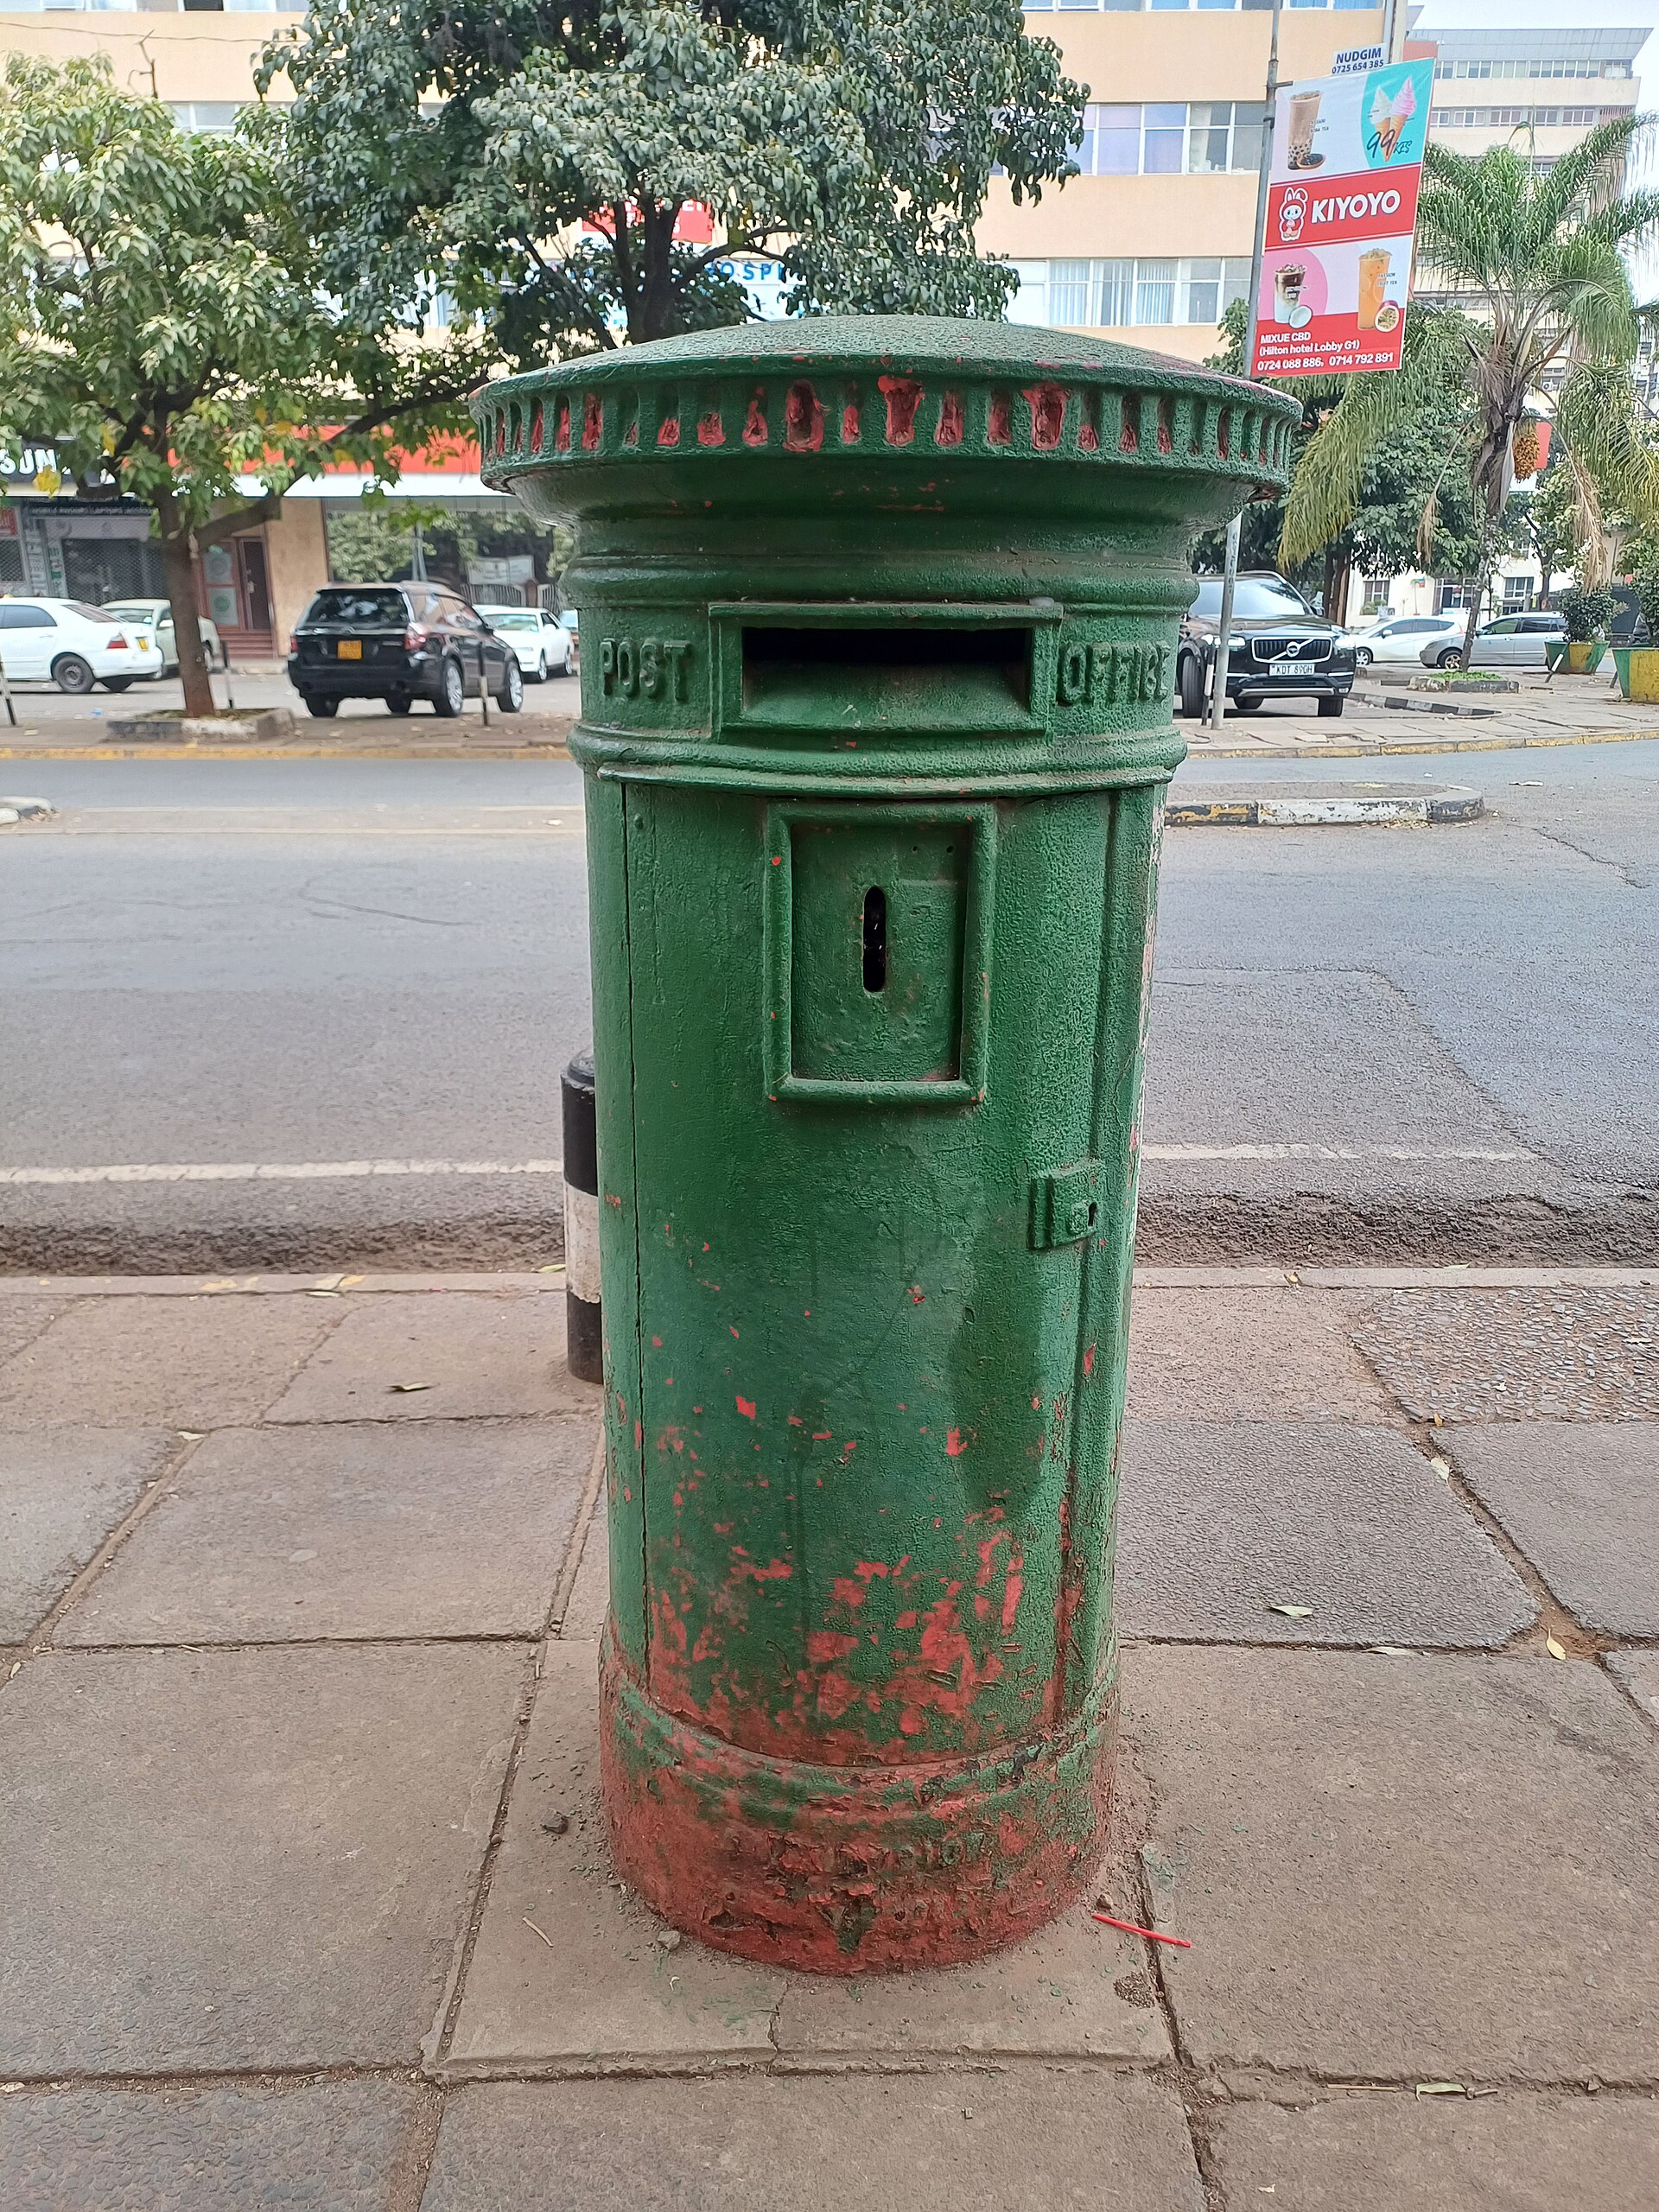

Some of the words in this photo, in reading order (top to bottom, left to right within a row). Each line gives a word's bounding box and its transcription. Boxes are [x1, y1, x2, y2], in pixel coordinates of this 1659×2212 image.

[1336, 47, 1382, 64] NUDGIM
[1332, 64, 1351, 74] 0725
[1352, 61, 1367, 71] 654
[1369, 59, 1384, 68] 385
[1366, 129, 1395, 158] 99
[1393, 140, 1413, 154] KES
[1311, 189, 1401, 224] KIYOYO
[1260, 334, 1290, 344] MIXUE
[1291, 332, 1311, 341] CBD
[1259, 345, 1288, 357] (Hilton
[1290, 342, 1313, 353] hotel
[1314, 341, 1343, 353] Lobby
[1344, 339, 1360, 351] G1)
[1257, 359, 1281, 371] 0724
[1282, 359, 1301, 369] 088
[1329, 354, 1352, 366] 0714
[1355, 353, 1373, 365] 792
[1375, 352, 1394, 363] 891
[599, 638, 691, 703] POST
[1058, 640, 1172, 705] OFFICE
[1276, 664, 1291, 674] KDT
